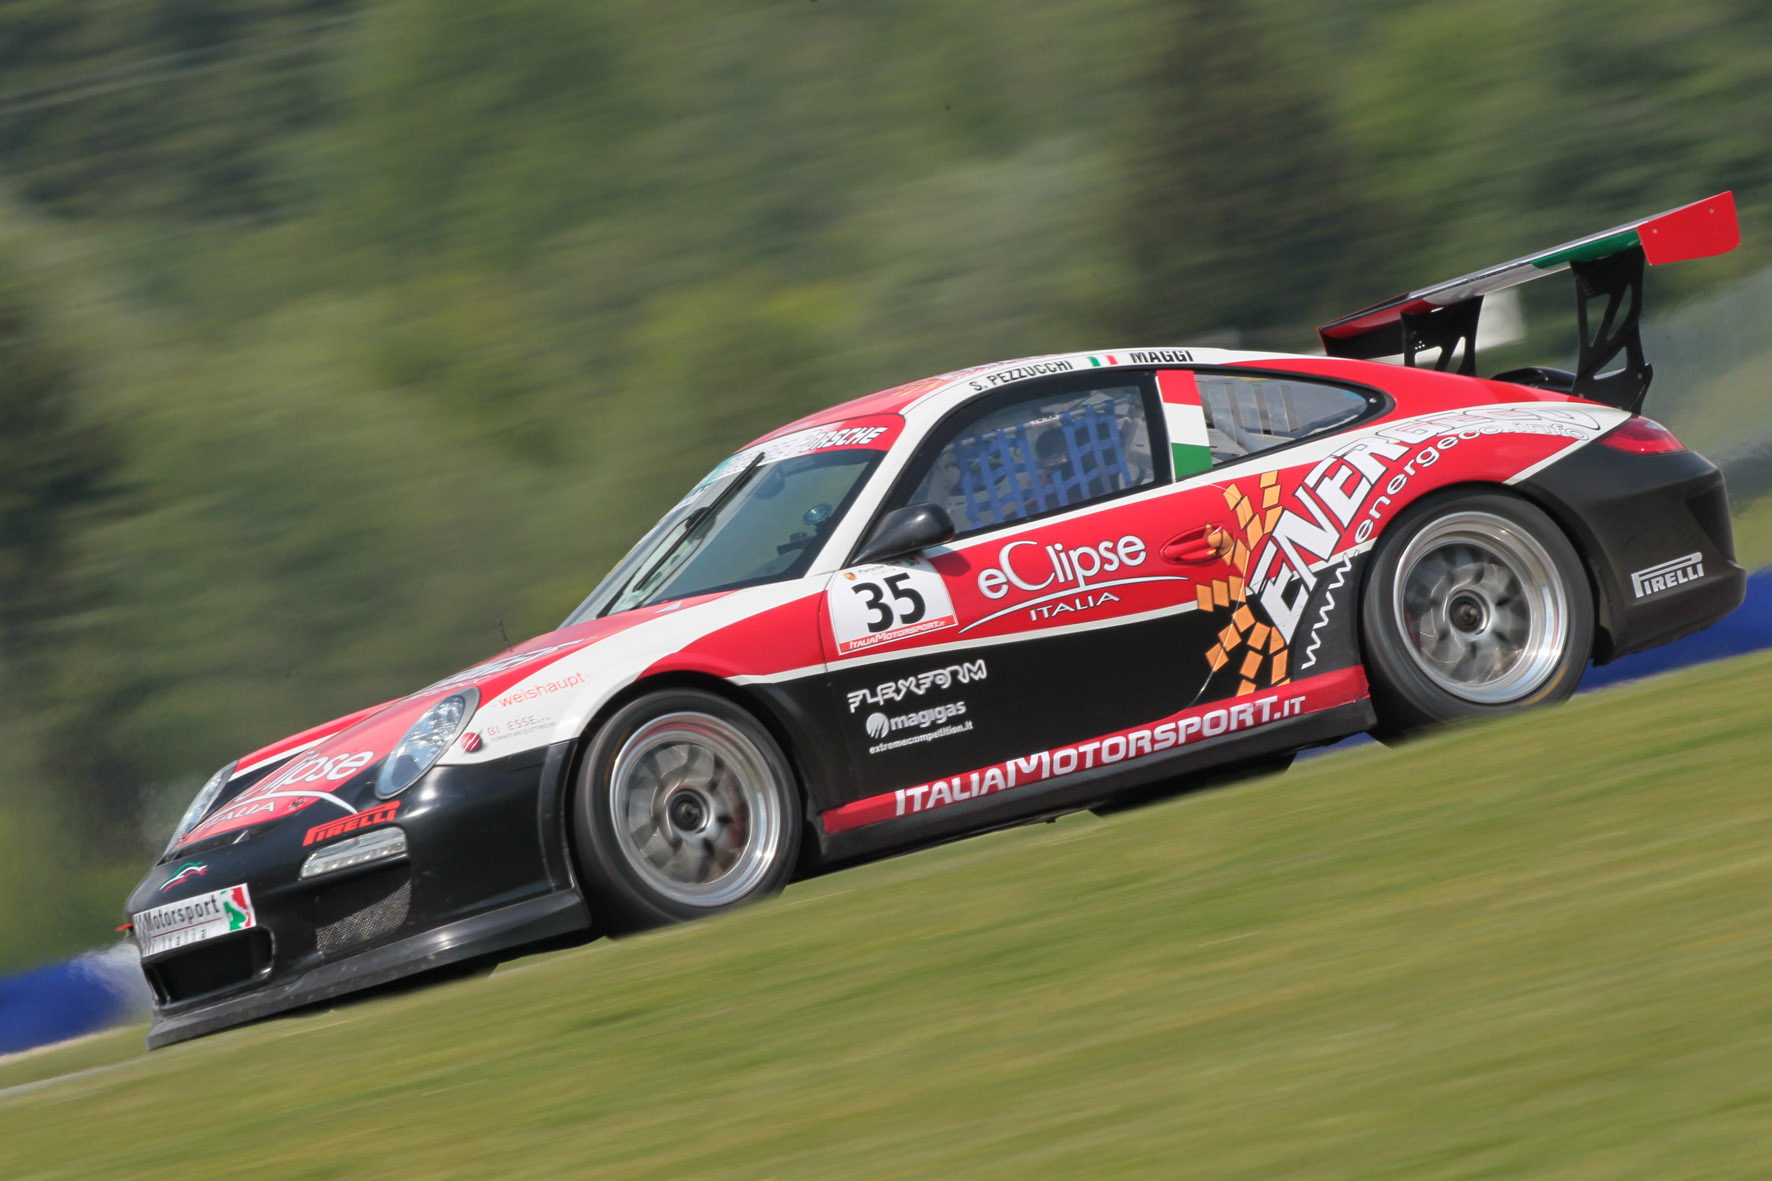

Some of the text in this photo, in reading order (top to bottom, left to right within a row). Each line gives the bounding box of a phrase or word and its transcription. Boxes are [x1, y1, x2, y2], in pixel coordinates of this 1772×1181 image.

[1129, 350, 1194, 364] MAGGI
[969, 381, 988, 392] S.
[986, 360, 1075, 386] PEZZUCCHI
[977, 535, 1147, 599] eClipse
[1630, 551, 1704, 598] PIRELLI
[851, 572, 926, 633] 35
[1029, 591, 1121, 622] ITALIA
[498, 671, 586, 708] weishaupt
[847, 659, 987, 713] FLEXFORM
[506, 715, 536, 731] ESSE
[889, 701, 967, 731] magigas
[869, 720, 974, 754] extremecompetition.it
[302, 800, 401, 847] PIRELLI
[142, 895, 220, 933] Motorsport
